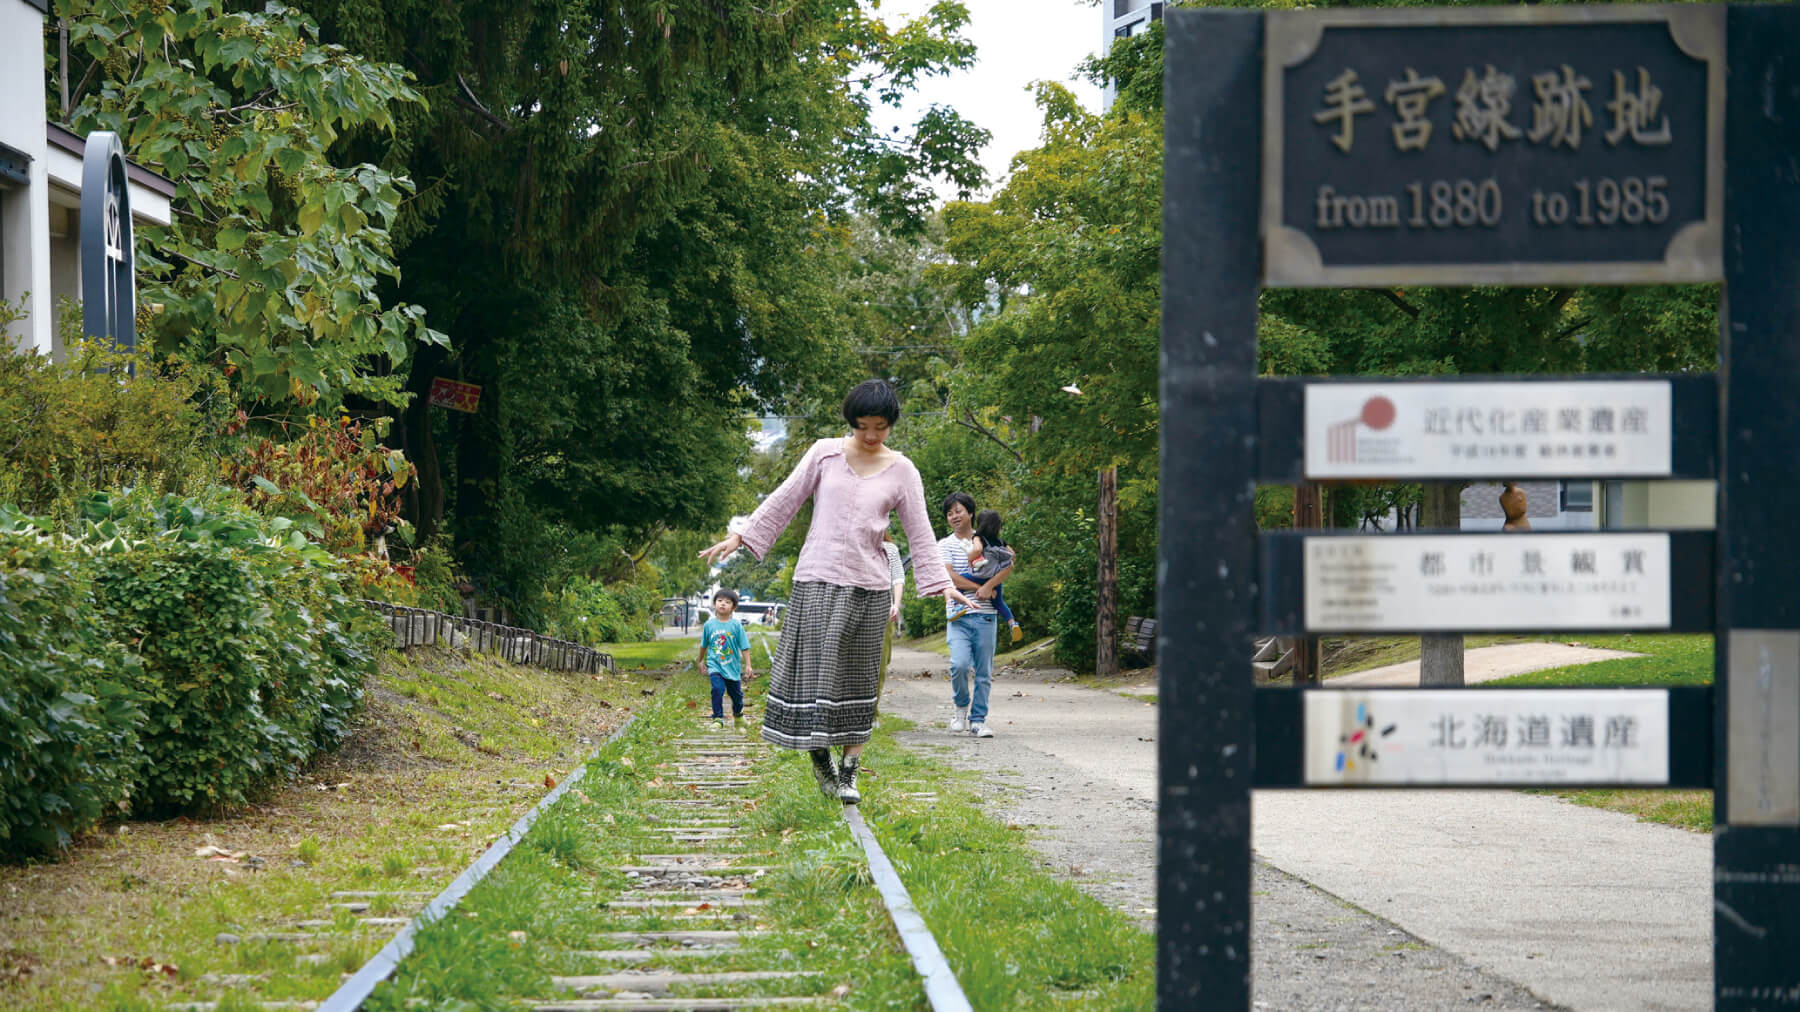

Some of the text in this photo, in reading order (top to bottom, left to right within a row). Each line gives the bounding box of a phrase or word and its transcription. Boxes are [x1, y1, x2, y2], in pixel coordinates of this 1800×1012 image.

[1313, 63, 1673, 153] 手宮線跡地
[1315, 176, 1670, 228] from 1880 to 1985
[1424, 407, 1649, 436] 近代化産業遺産
[1420, 550, 1646, 576] 都市景観賞
[1430, 713, 1639, 750] 北海道遺産
